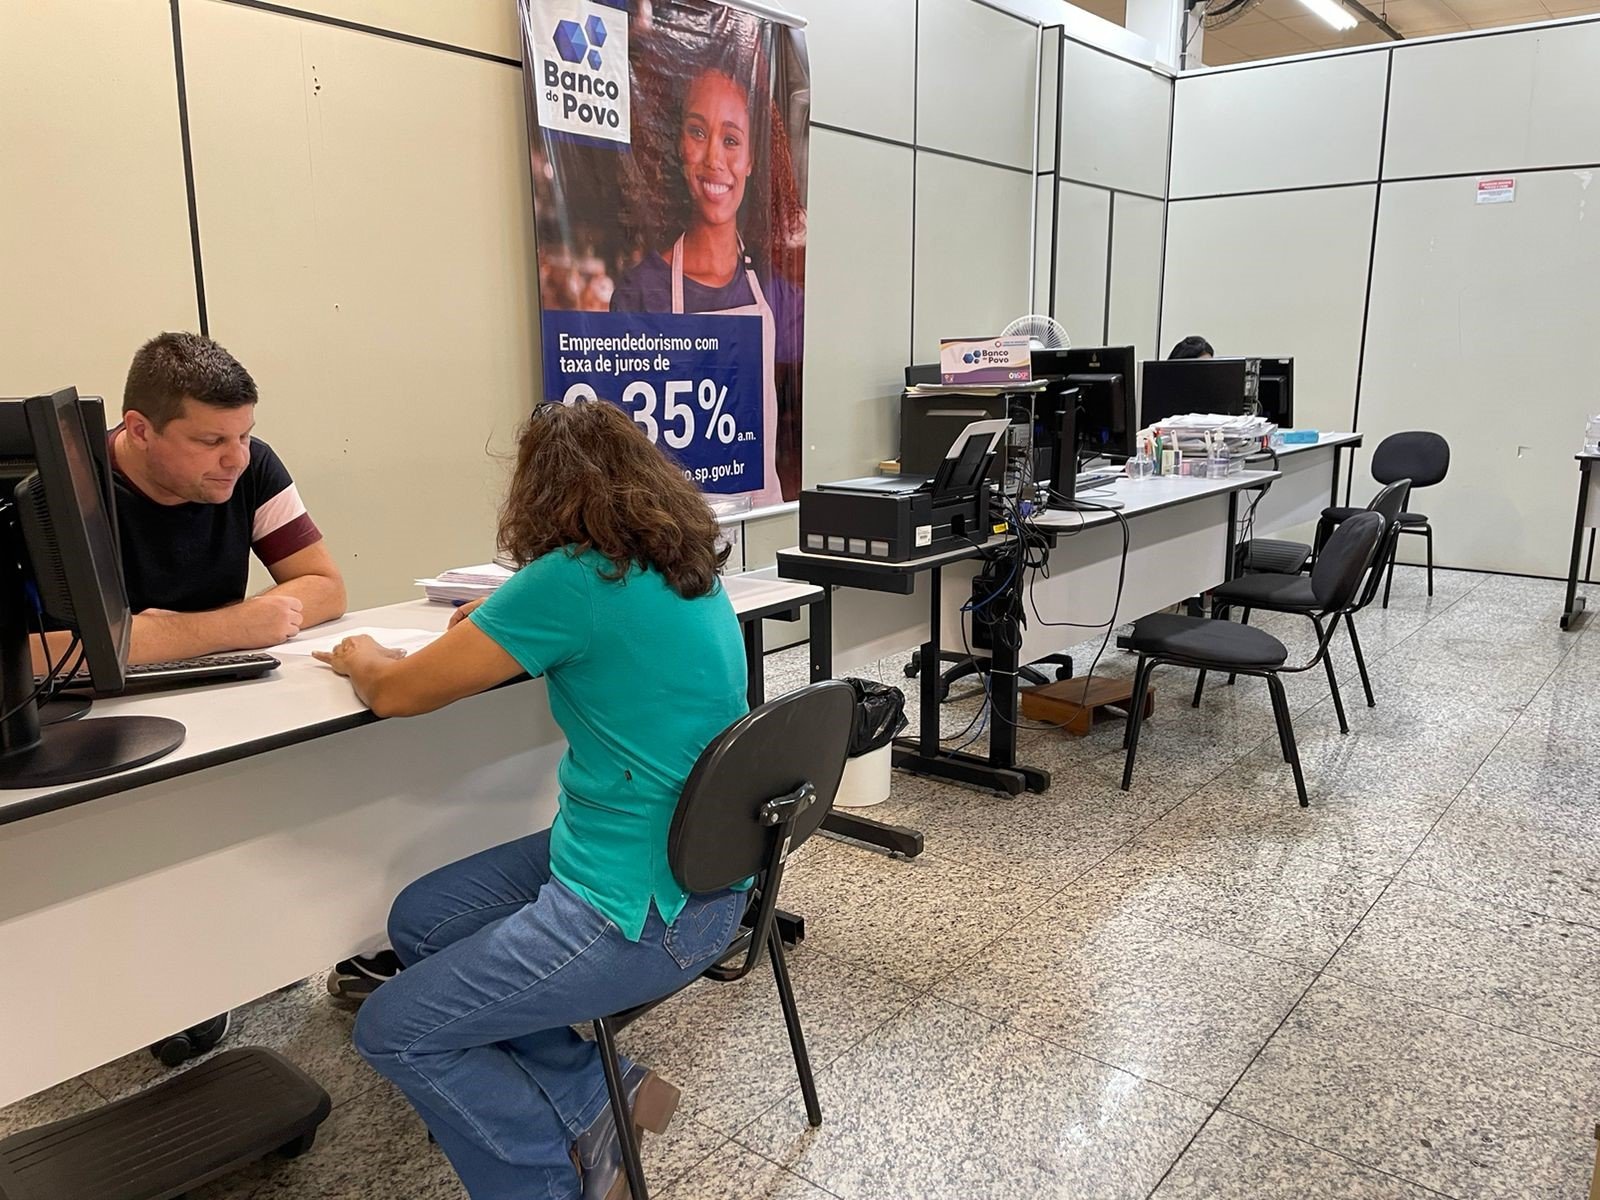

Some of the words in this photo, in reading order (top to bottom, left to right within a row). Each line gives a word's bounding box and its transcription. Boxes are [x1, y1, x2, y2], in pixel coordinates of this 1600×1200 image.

[544, 59, 618, 100] Banco
[546, 90, 558, 102] do
[563, 92, 619, 128] Povo
[559, 333, 692, 355] Empreendedorismo
[695, 337, 719, 350] com
[560, 356, 592, 373] taxa
[595, 354, 611, 372] de
[614, 354, 650, 376] juros
[653, 353, 670, 371] de
[563, 378, 736, 449] 35%
[738, 432, 756, 442] a.m.
[682, 459, 745, 484] o.sp.gov.br
